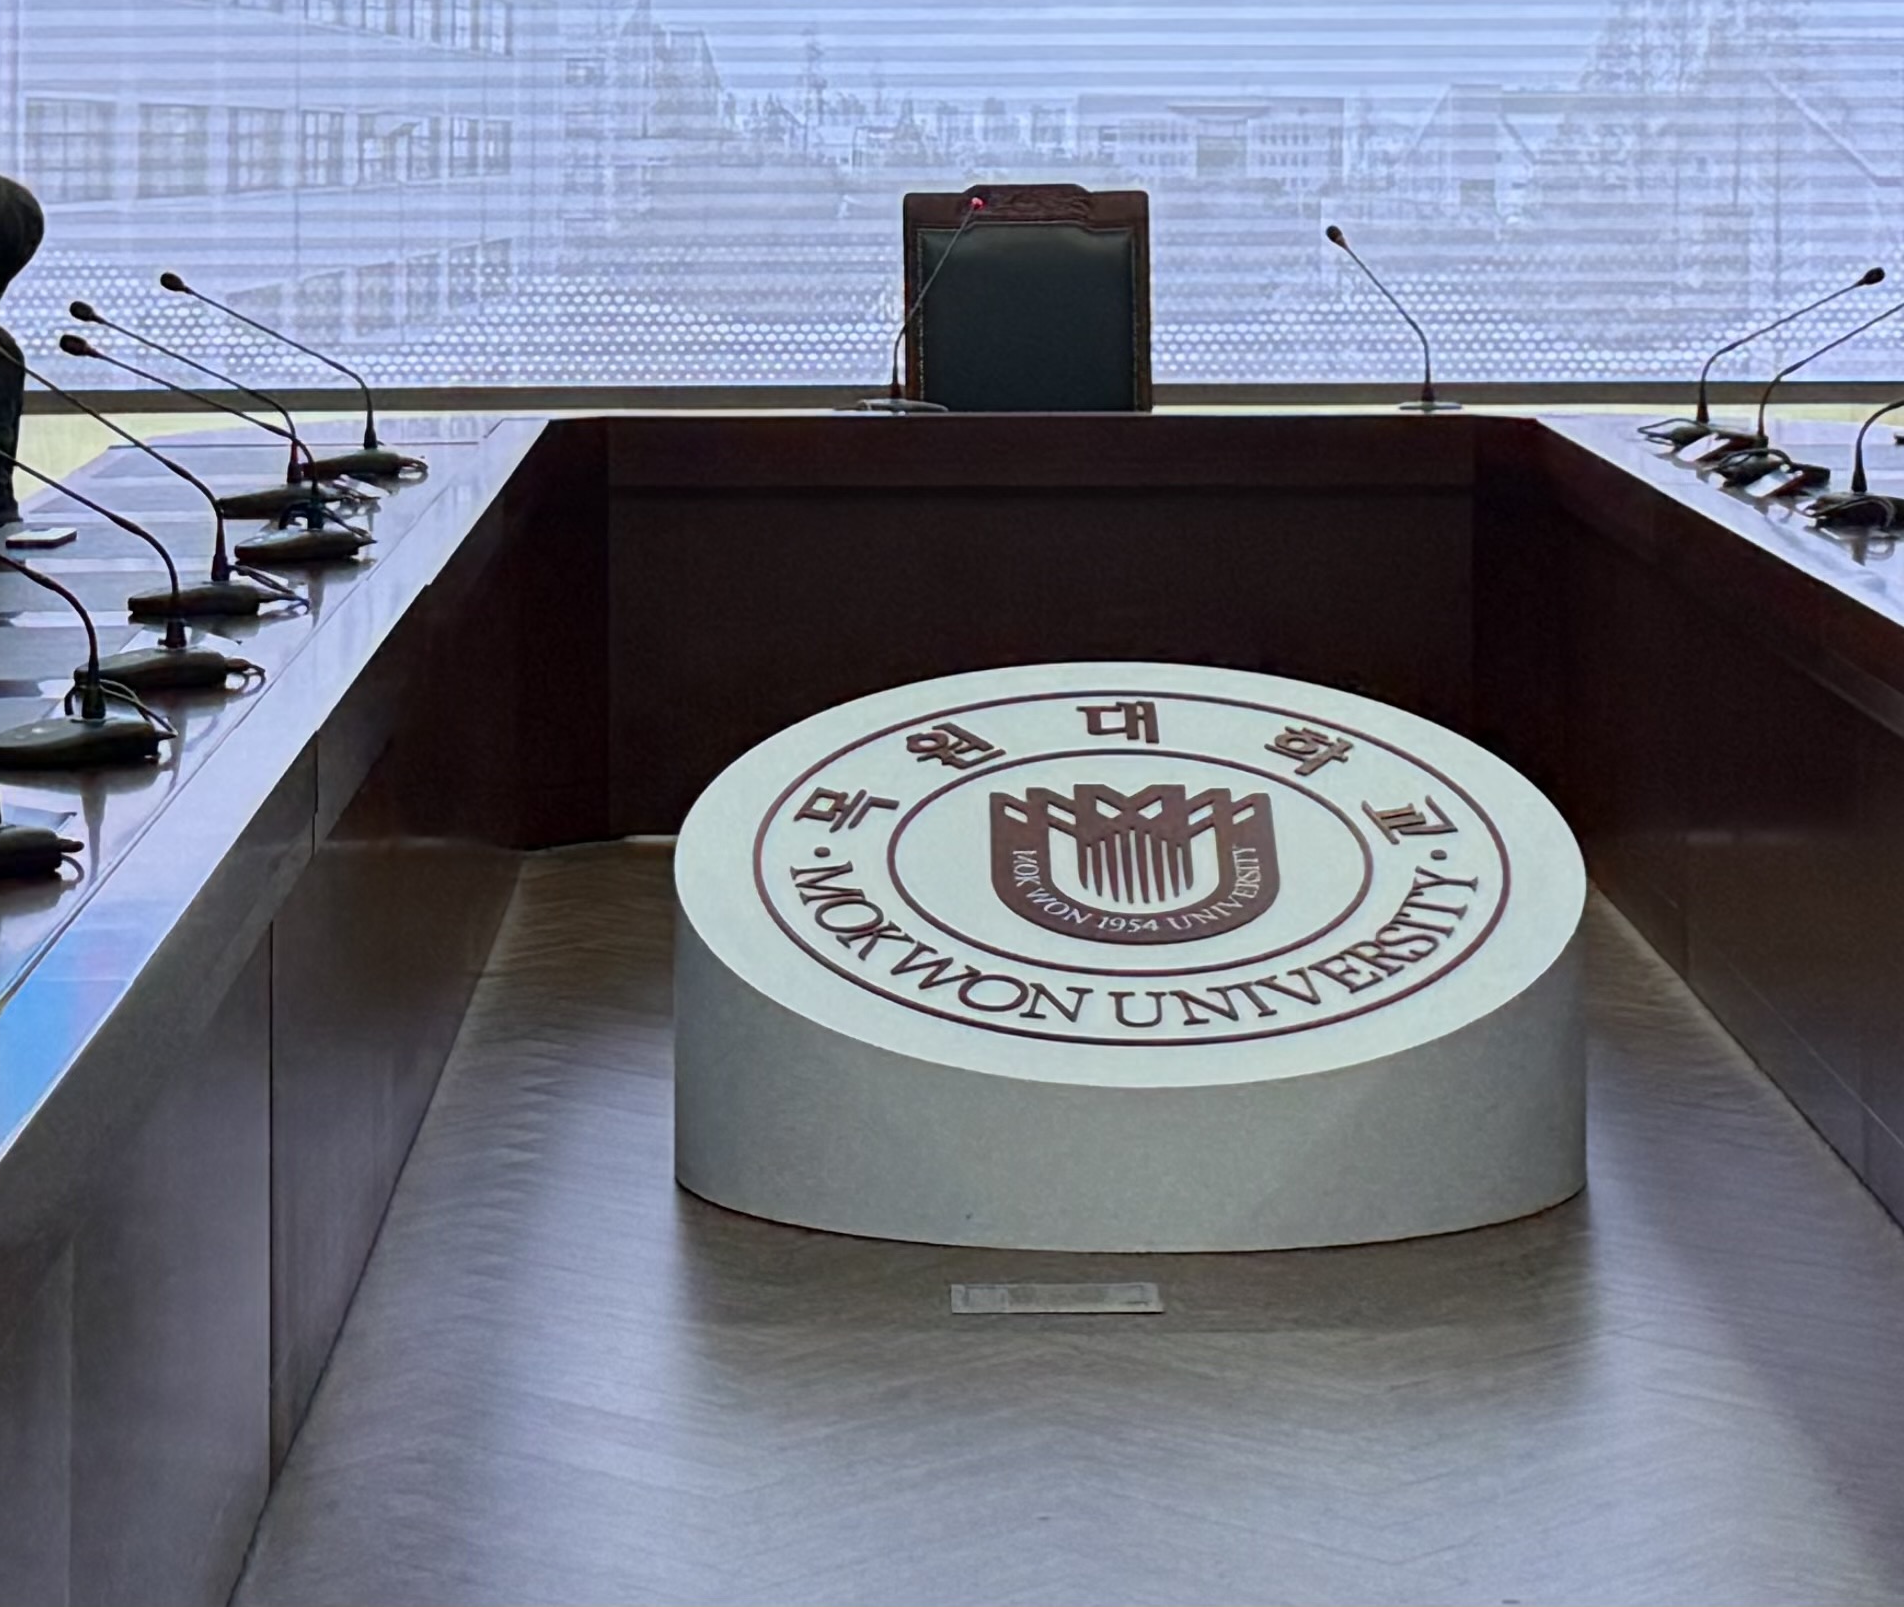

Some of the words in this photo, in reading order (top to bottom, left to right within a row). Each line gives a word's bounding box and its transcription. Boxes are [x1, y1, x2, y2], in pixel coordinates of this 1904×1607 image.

[1097, 915, 1159, 933] 1954
[1166, 844, 1257, 931] UNIVERSITY
[1107, 864, 1480, 1028] UNIVERSITY
